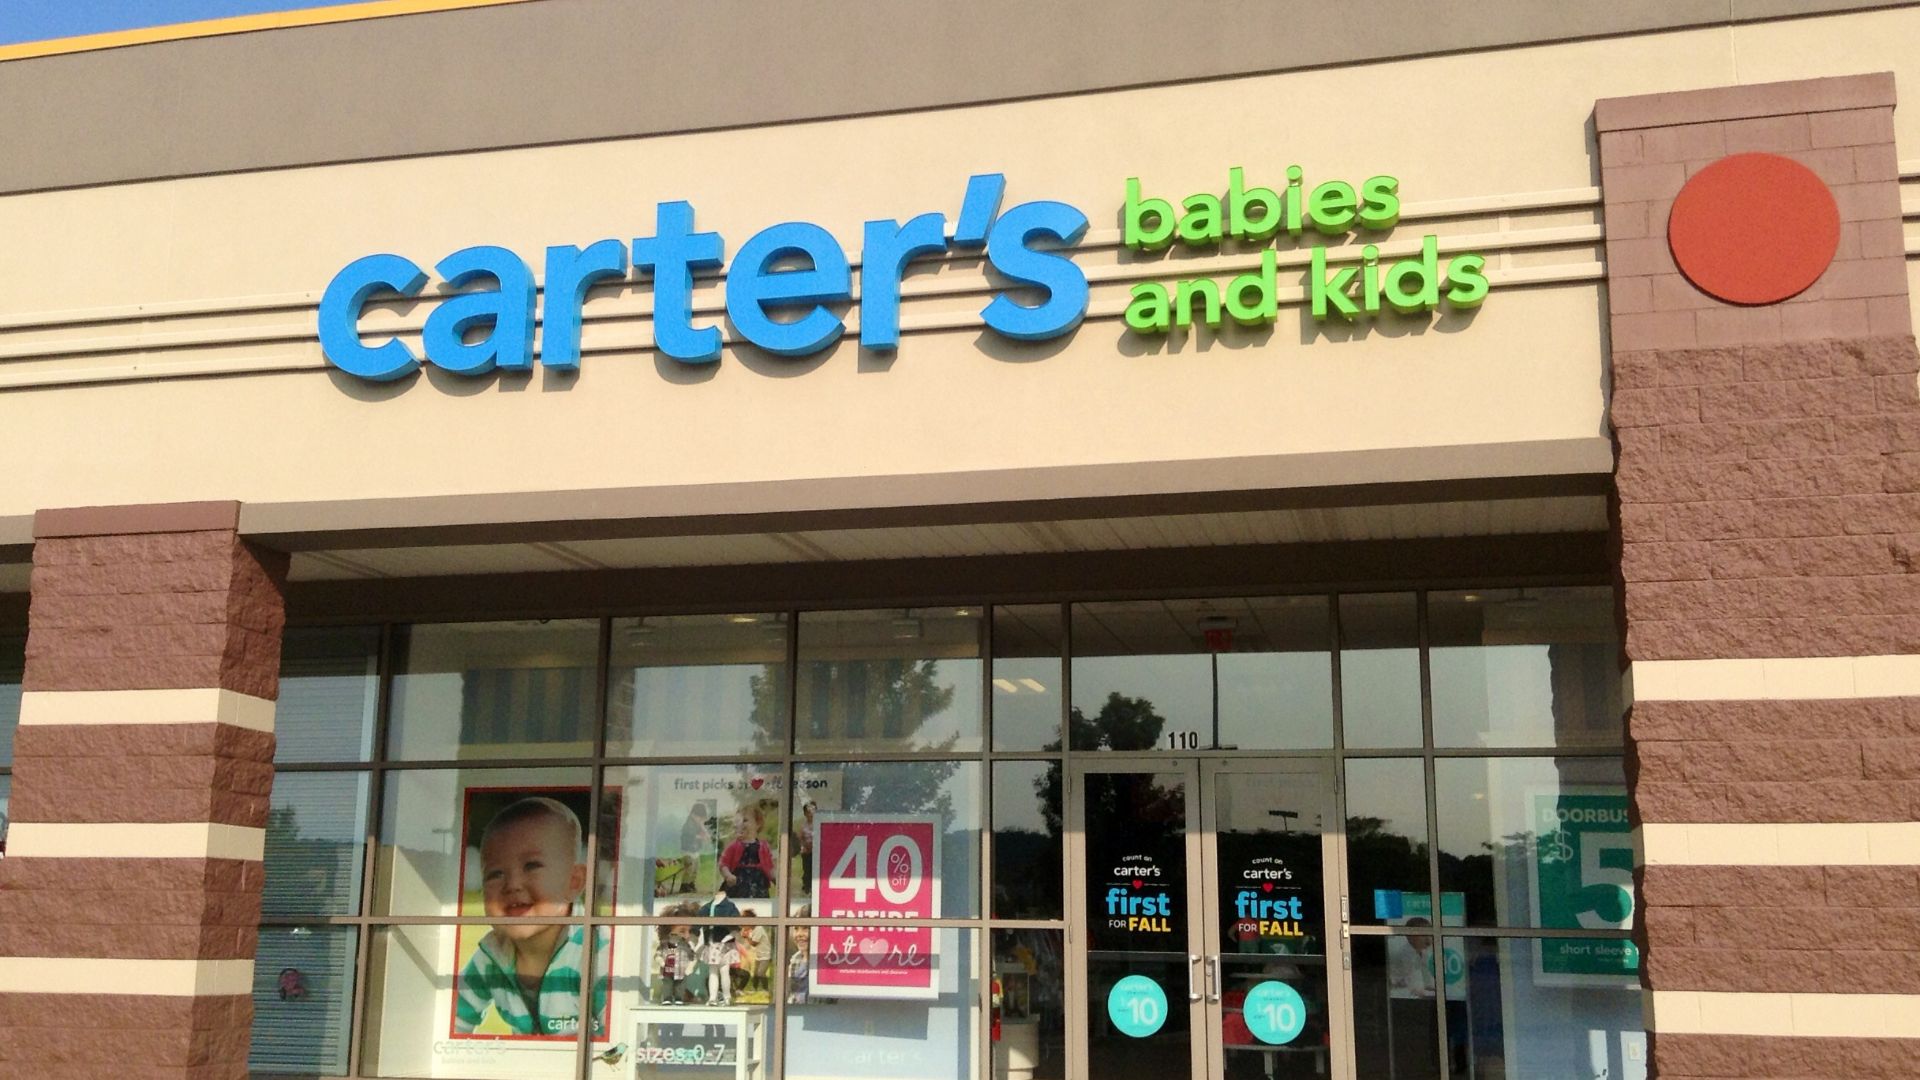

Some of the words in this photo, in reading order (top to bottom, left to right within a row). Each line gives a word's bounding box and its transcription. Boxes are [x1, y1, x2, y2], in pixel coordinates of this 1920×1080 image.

[1124, 164, 1400, 251] babies
[318, 172, 1089, 382] carter's
[1125, 247, 1278, 334] and
[1311, 235, 1490, 321] kids
[1168, 731, 1198, 749] 110
[674, 778, 699, 790] first
[702, 778, 734, 792] picks
[1122, 854, 1143, 862] count
[828, 834, 923, 905] 40
[1113, 865, 1161, 877] carter's
[1243, 868, 1293, 880] carter's
[892, 875, 907, 886] off
[1105, 888, 1171, 916] first
[1234, 891, 1304, 920] first
[1108, 919, 1127, 928] FOR
[1128, 916, 1172, 932] FALL
[1238, 923, 1257, 932] FOR
[1259, 920, 1304, 936] FALL
[1560, 943, 1591, 956] short
[636, 1041, 685, 1062] sizes
